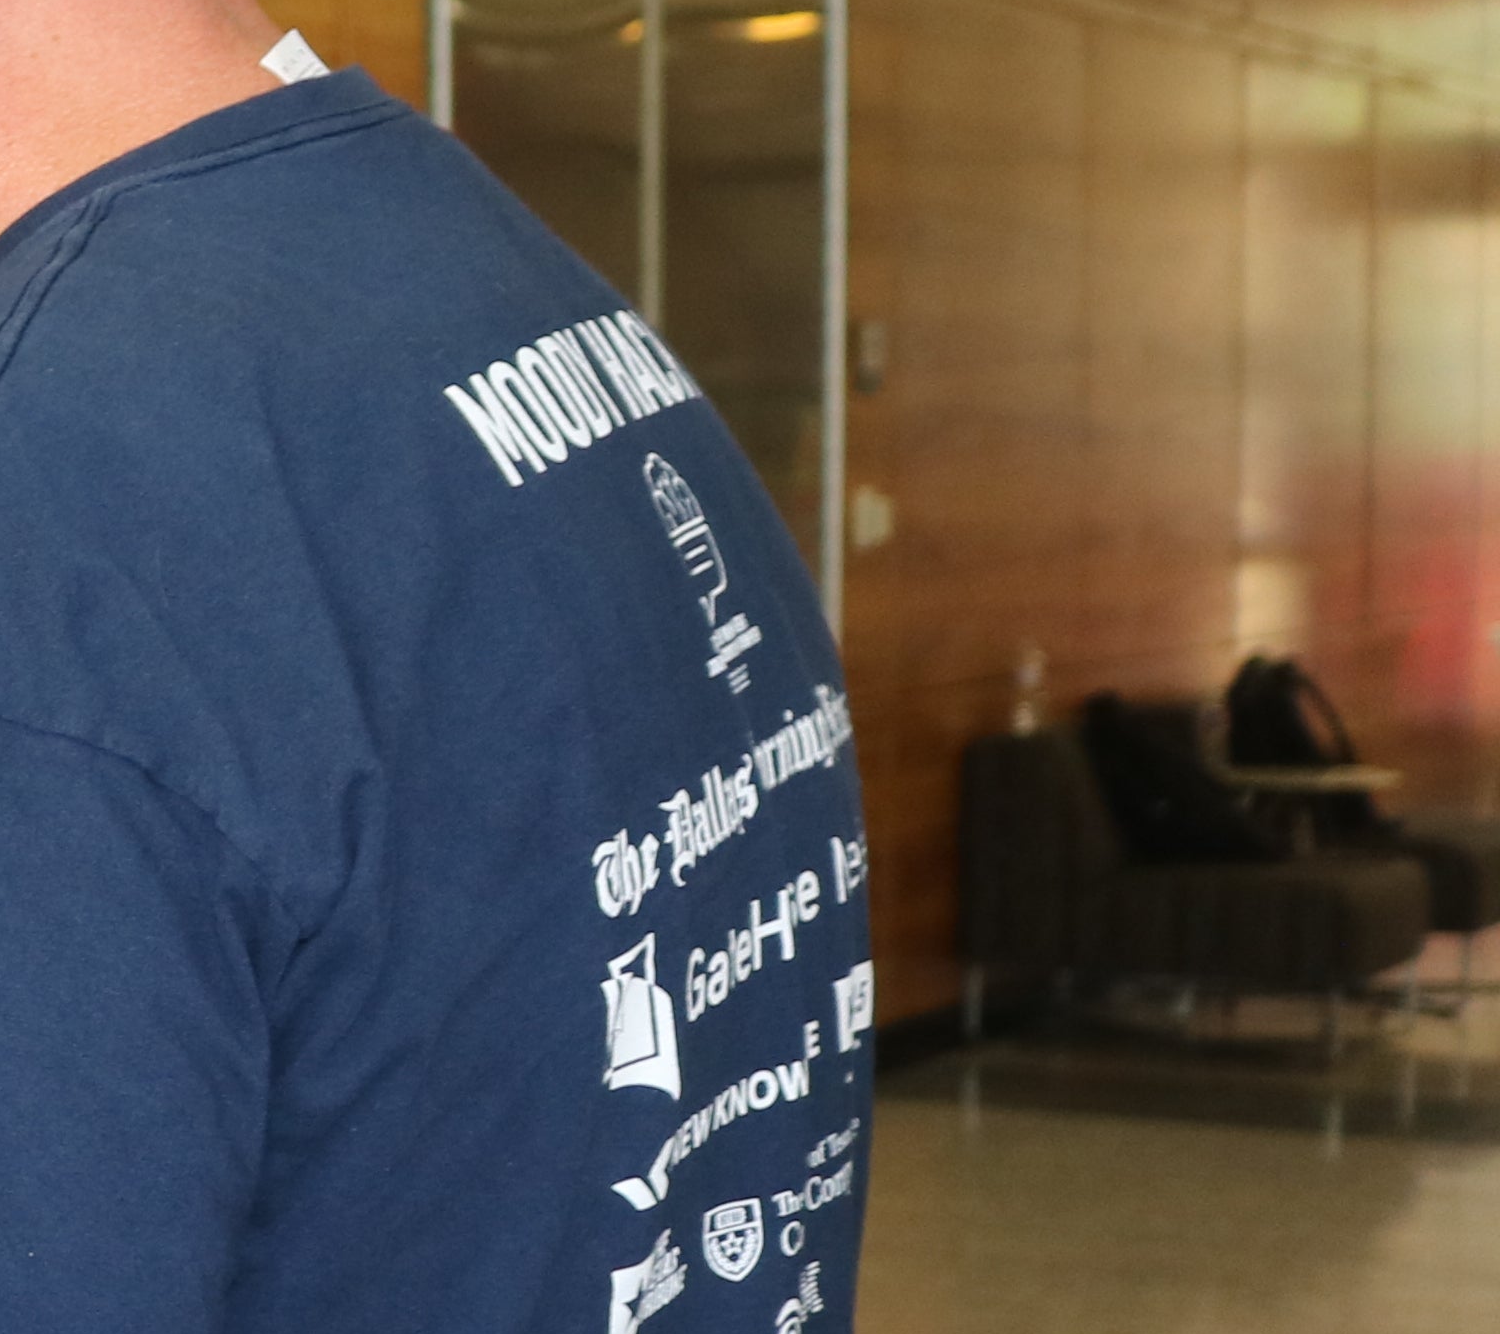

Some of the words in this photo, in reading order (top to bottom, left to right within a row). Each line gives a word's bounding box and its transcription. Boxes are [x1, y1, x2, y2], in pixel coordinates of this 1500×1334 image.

[442, 327, 627, 488] MOODY
[591, 828, 661, 919] The
[658, 753, 760, 889] Dallas
